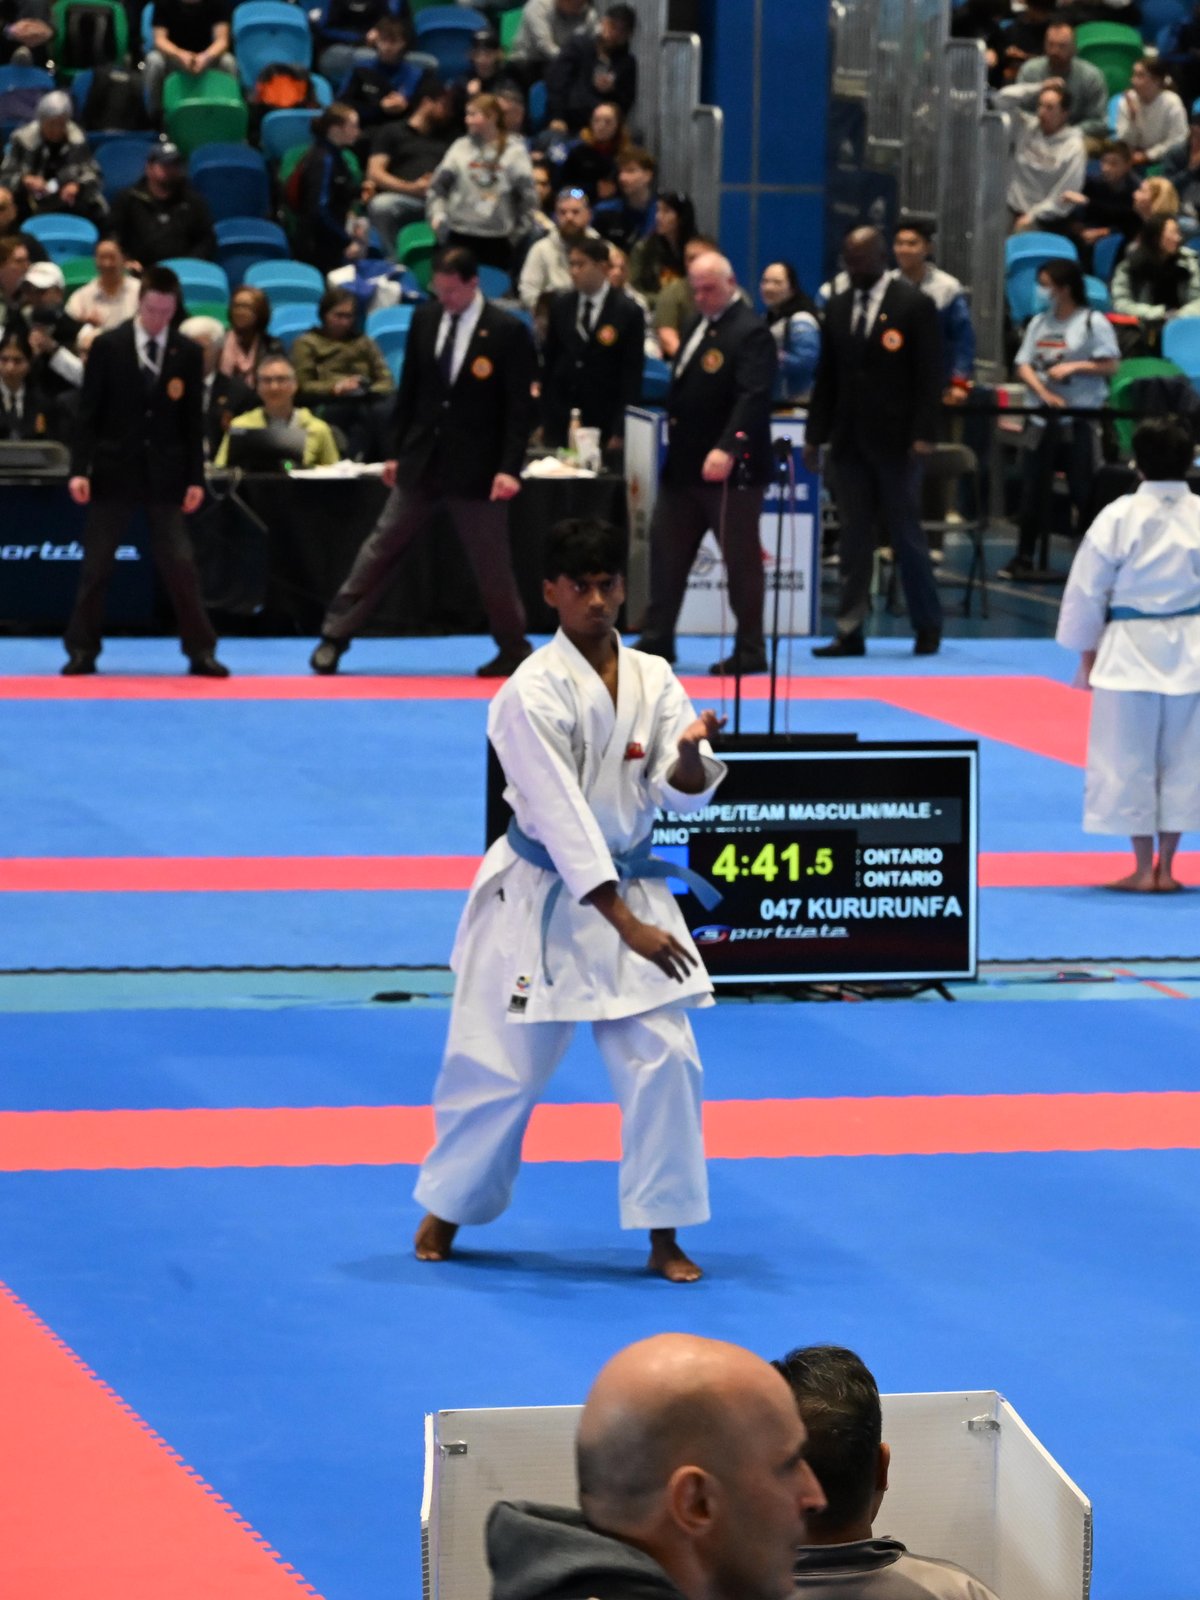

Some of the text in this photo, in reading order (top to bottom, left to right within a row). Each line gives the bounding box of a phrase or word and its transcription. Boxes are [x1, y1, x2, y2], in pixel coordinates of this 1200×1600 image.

[787, 801, 931, 821] MASCULIN/MALE
[711, 842, 834, 883] 4:41.5
[863, 847, 944, 866] ONTARIO
[863, 869, 944, 888] ONTARIO
[760, 895, 963, 921] 047 KURURUNFA
